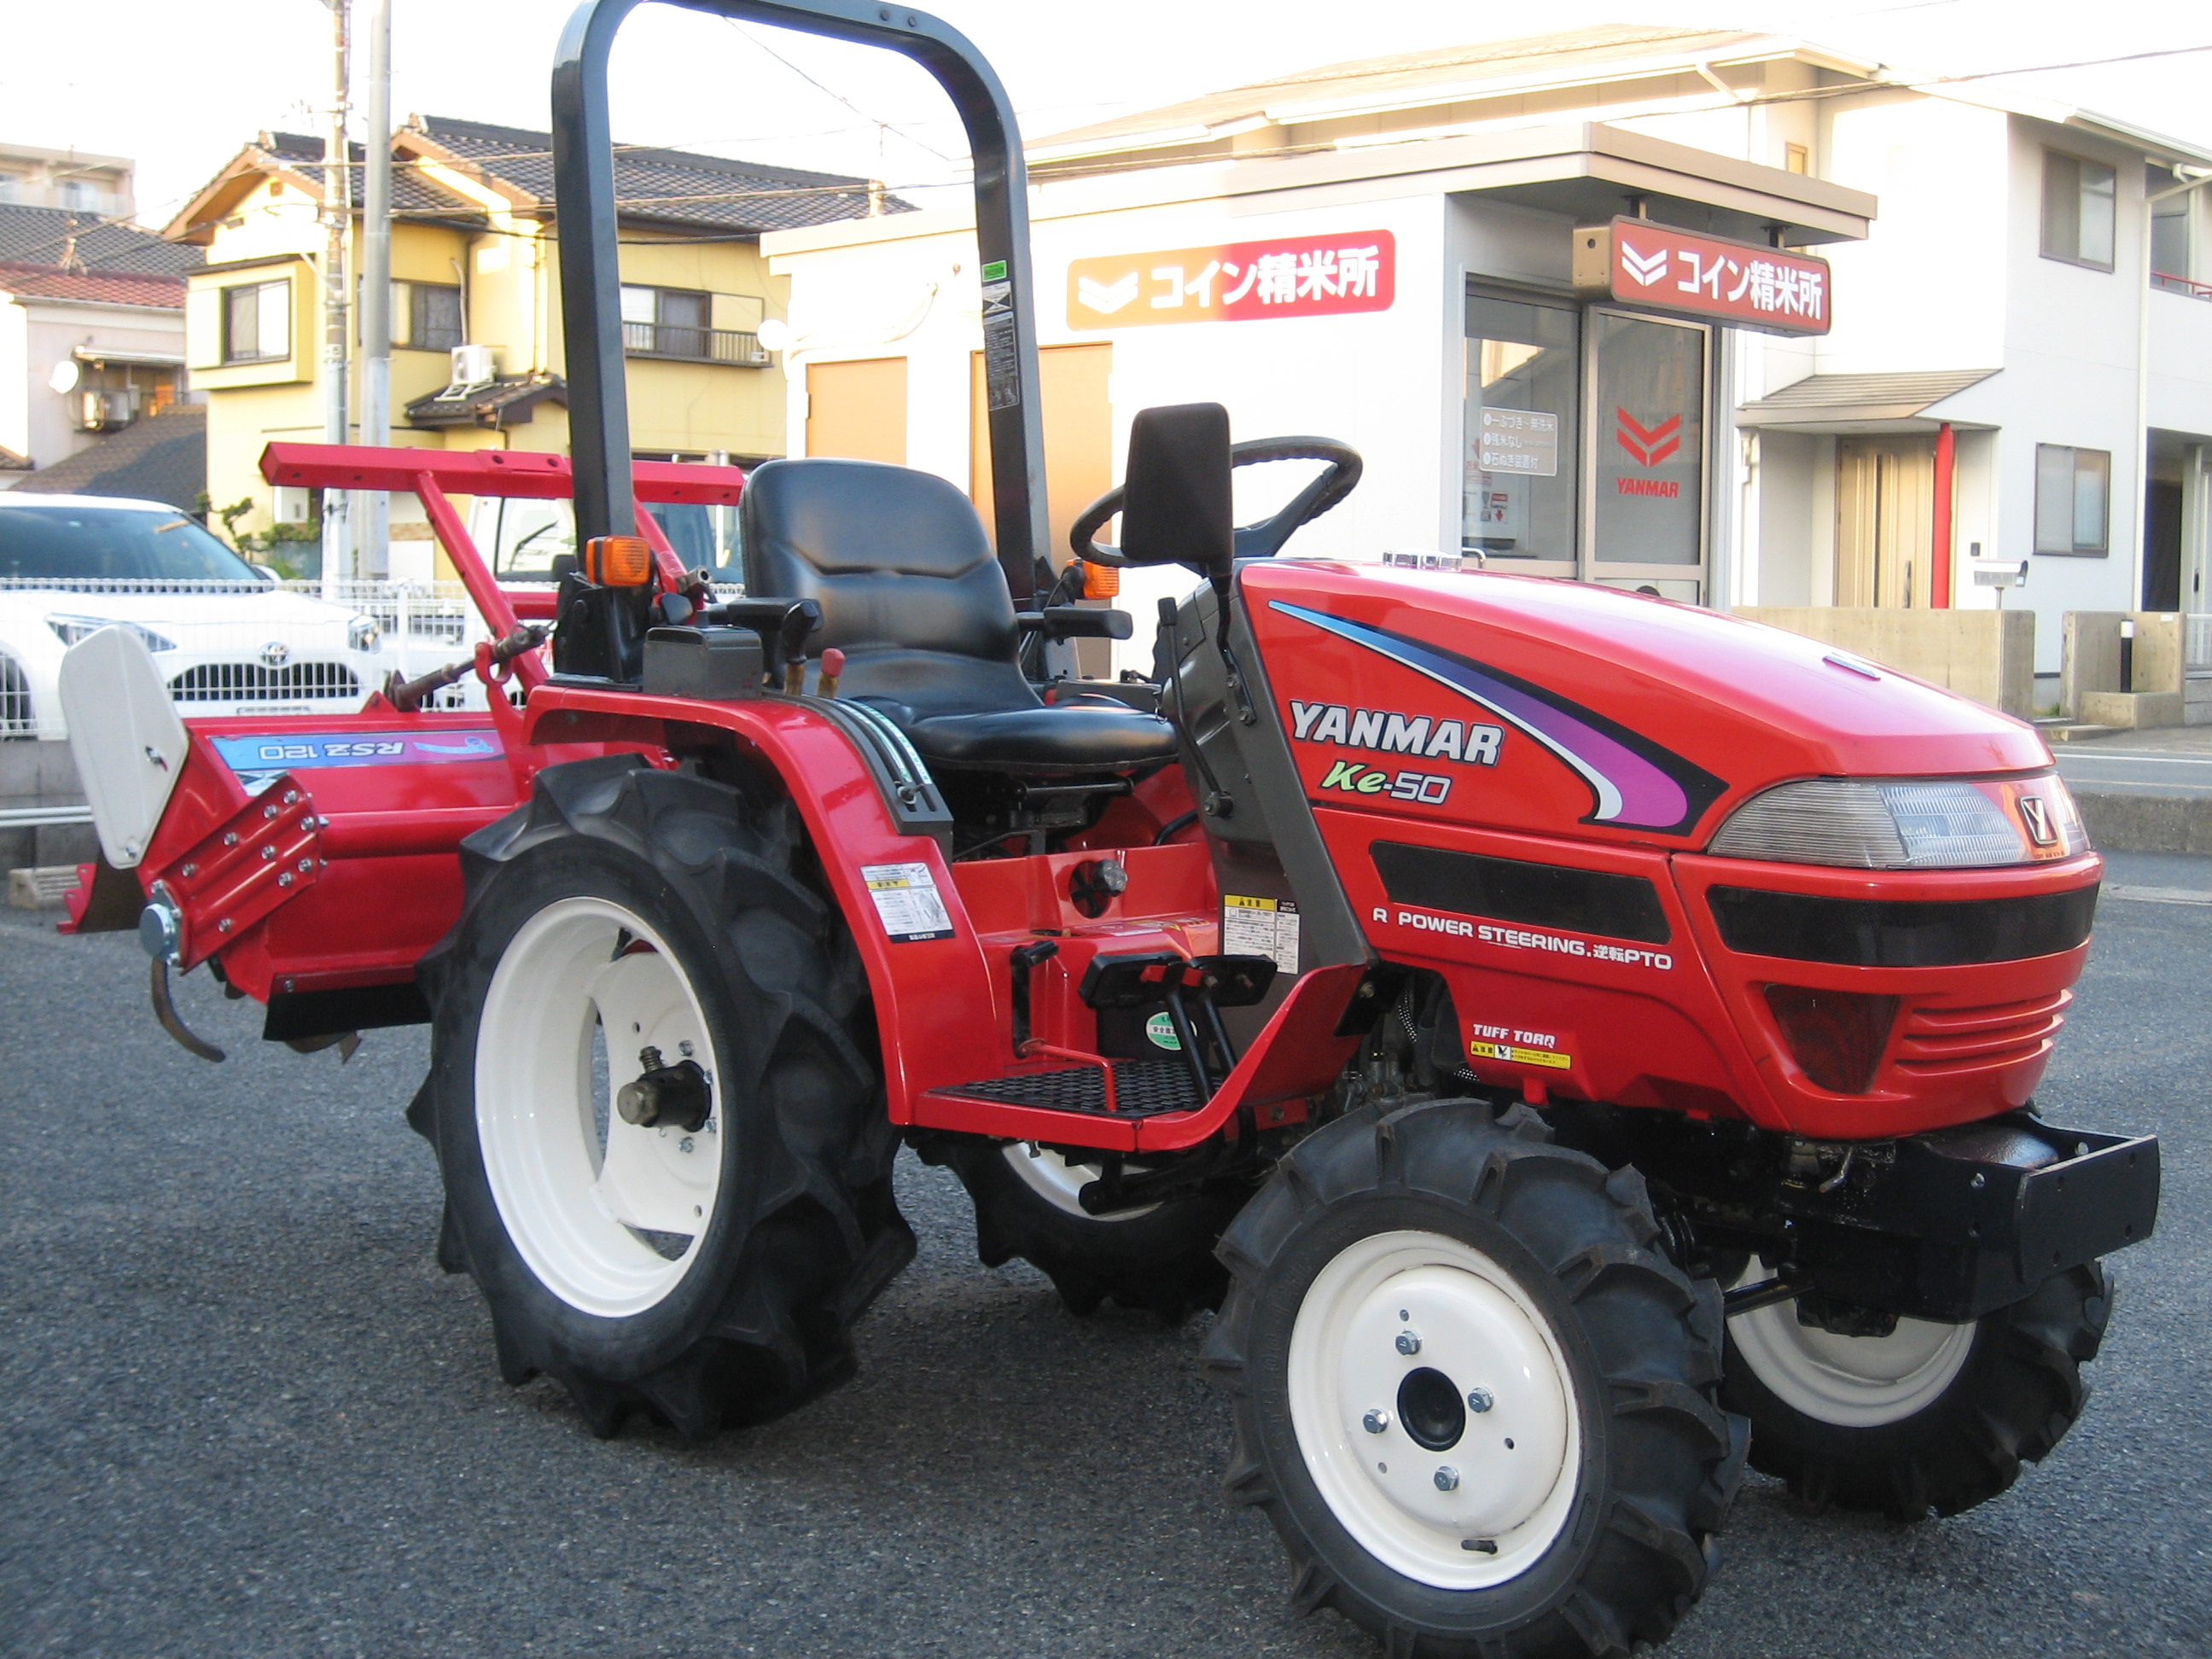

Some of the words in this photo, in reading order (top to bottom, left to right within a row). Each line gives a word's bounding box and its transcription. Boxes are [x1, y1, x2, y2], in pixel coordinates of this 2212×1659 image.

[1150, 244, 1379, 309] コイン精米所
[1677, 250, 1823, 321] コイン精米所
[1615, 476, 1679, 498] YANMAR
[1289, 700, 1504, 765] YANMAR
[259, 744, 319, 760] 120
[323, 741, 405, 758] RSZ
[1319, 760, 1452, 805] Ke-50
[1372, 907, 1388, 923] R
[1398, 911, 1474, 938] POWER
[1472, 1023, 1510, 1039] TUFF
[1513, 1029, 1556, 1049] TORQ
